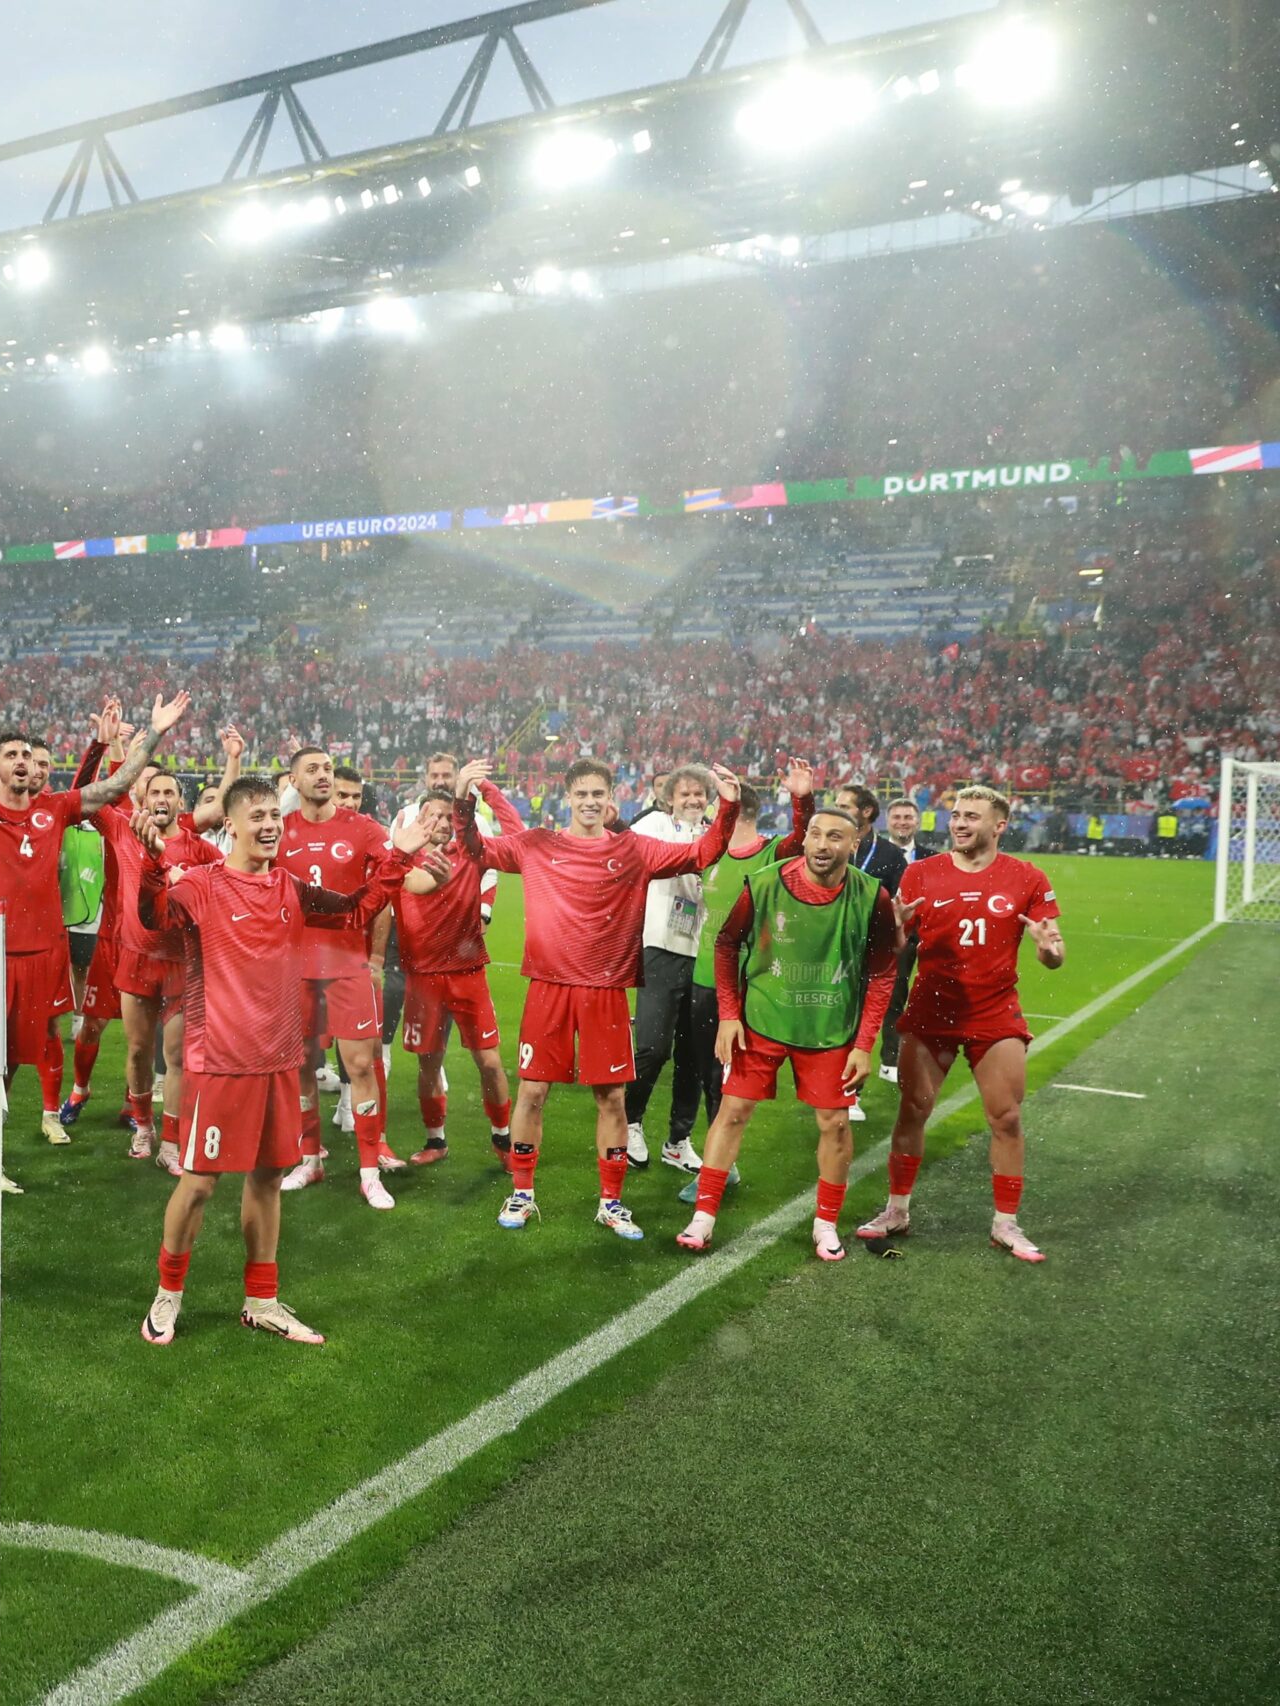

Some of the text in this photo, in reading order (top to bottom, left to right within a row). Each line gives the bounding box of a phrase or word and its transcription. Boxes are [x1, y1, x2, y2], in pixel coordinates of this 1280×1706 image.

[884, 463, 1071, 495] DORTMUND
[20, 834, 33, 857] 4
[309, 865, 322, 887] 3
[959, 918, 986, 946] 21
[204, 1125, 221, 1160] 8
